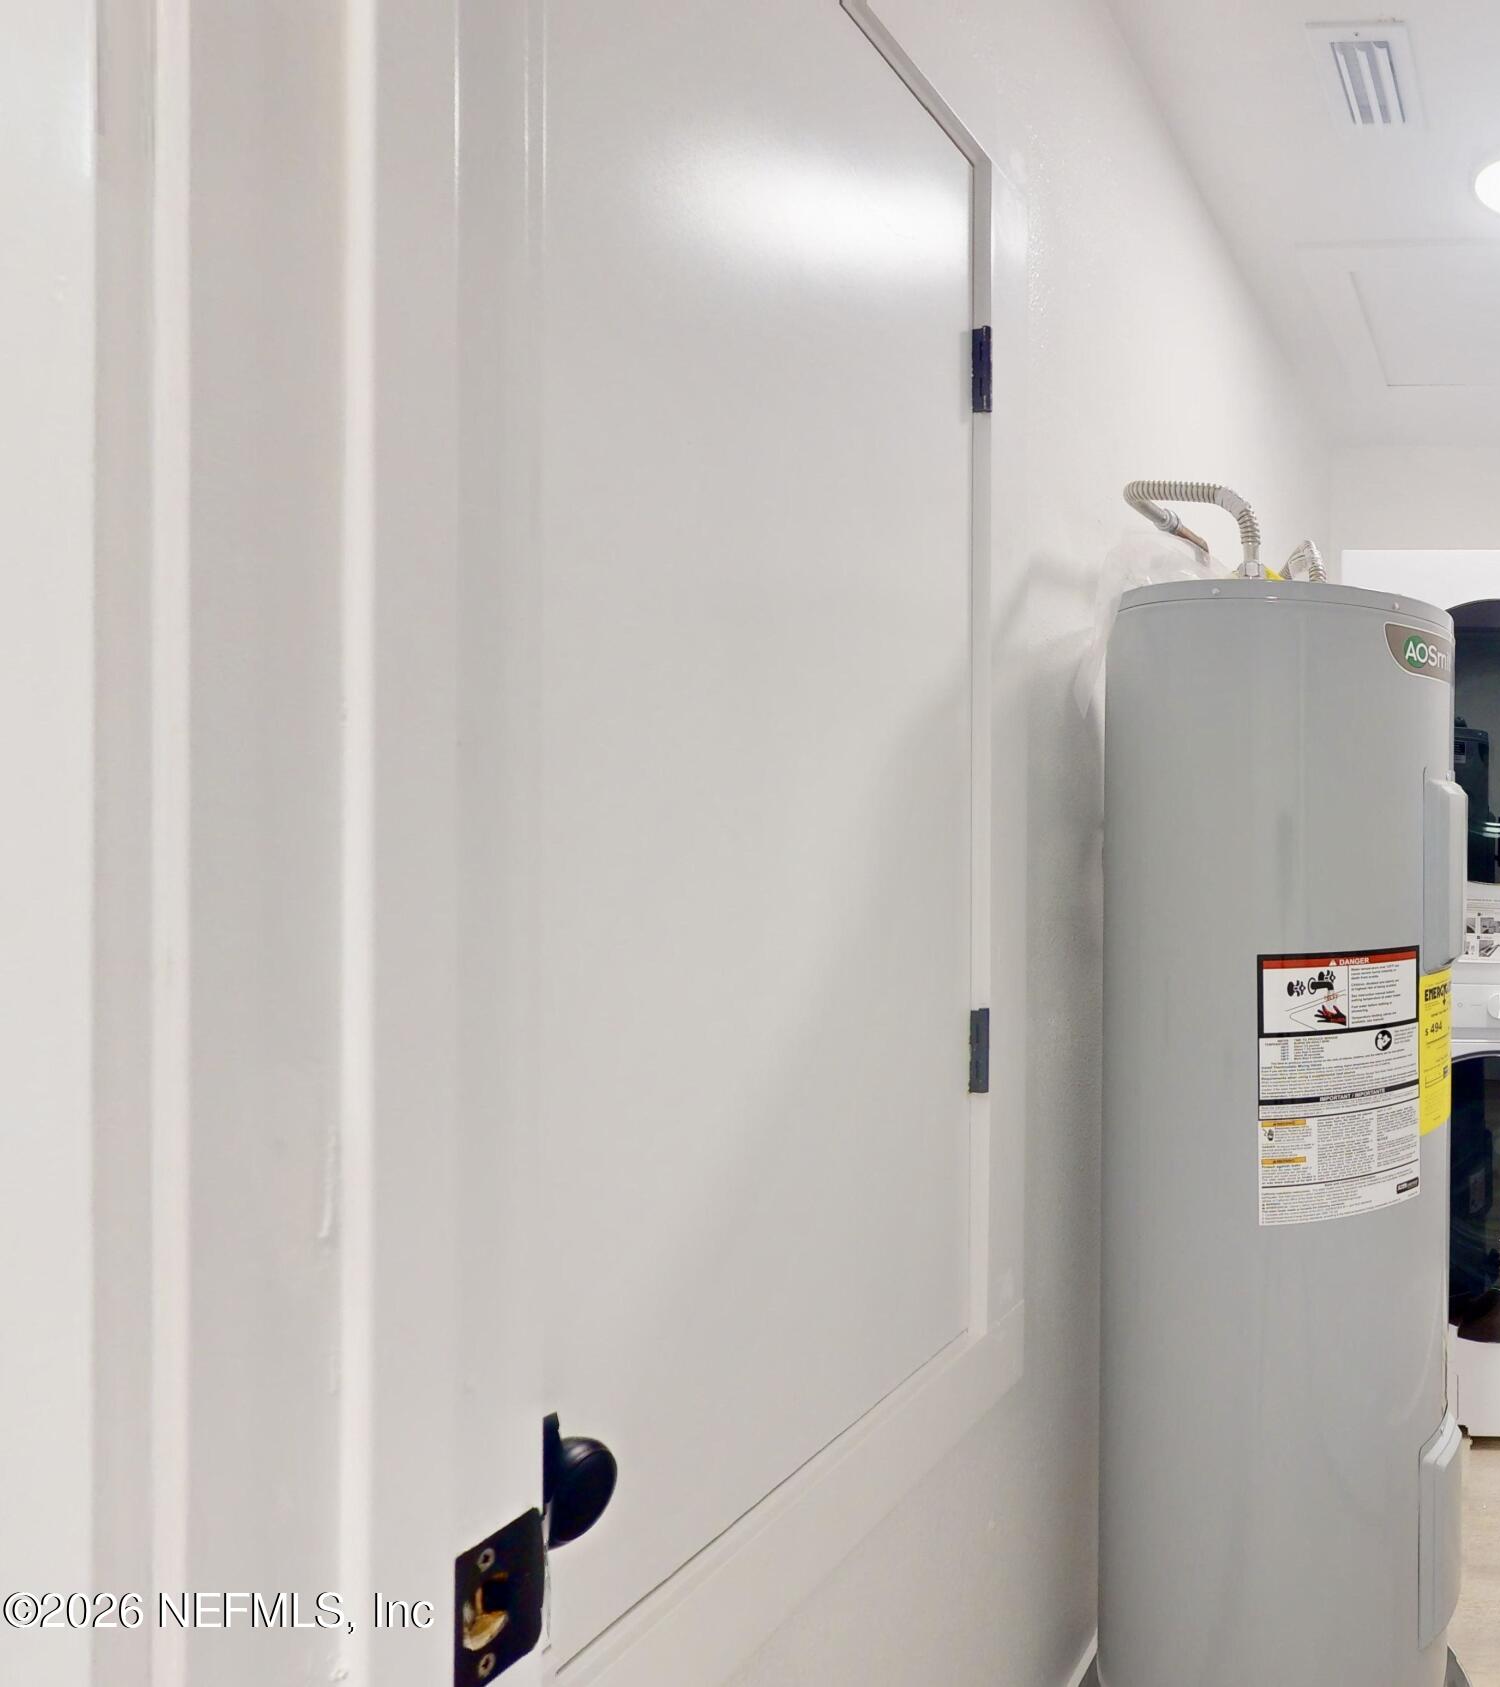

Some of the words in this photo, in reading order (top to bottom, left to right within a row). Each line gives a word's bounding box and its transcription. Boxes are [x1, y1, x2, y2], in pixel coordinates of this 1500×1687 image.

[1405, 640, 1451, 672] AOSmi
[1339, 956, 1369, 966] DANGER
[1319, 1093, 1352, 1102] IMPORTANT
